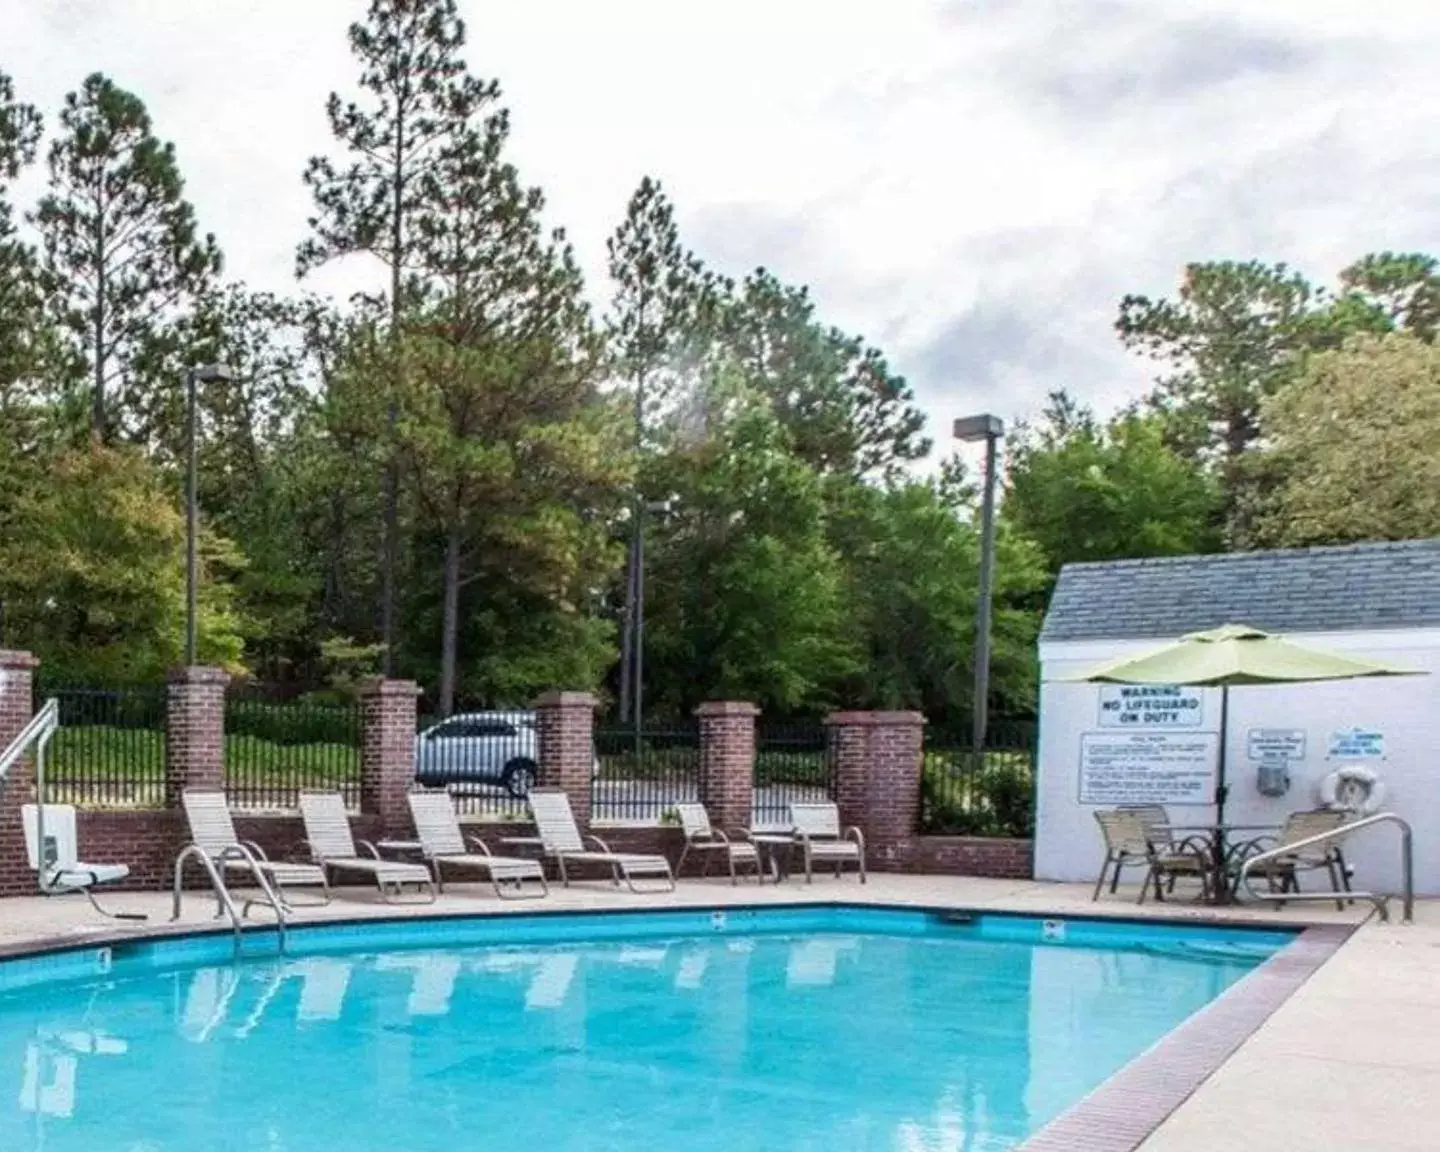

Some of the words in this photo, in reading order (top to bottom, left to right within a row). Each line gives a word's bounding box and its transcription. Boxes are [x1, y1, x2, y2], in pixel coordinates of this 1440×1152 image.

[1121, 686, 1181, 698] WARNING
[1102, 700, 1121, 711] NO
[1126, 698, 1199, 710] LIFEGUARD
[1120, 712, 1138, 723] ON
[1143, 711, 1179, 723] DUTY
